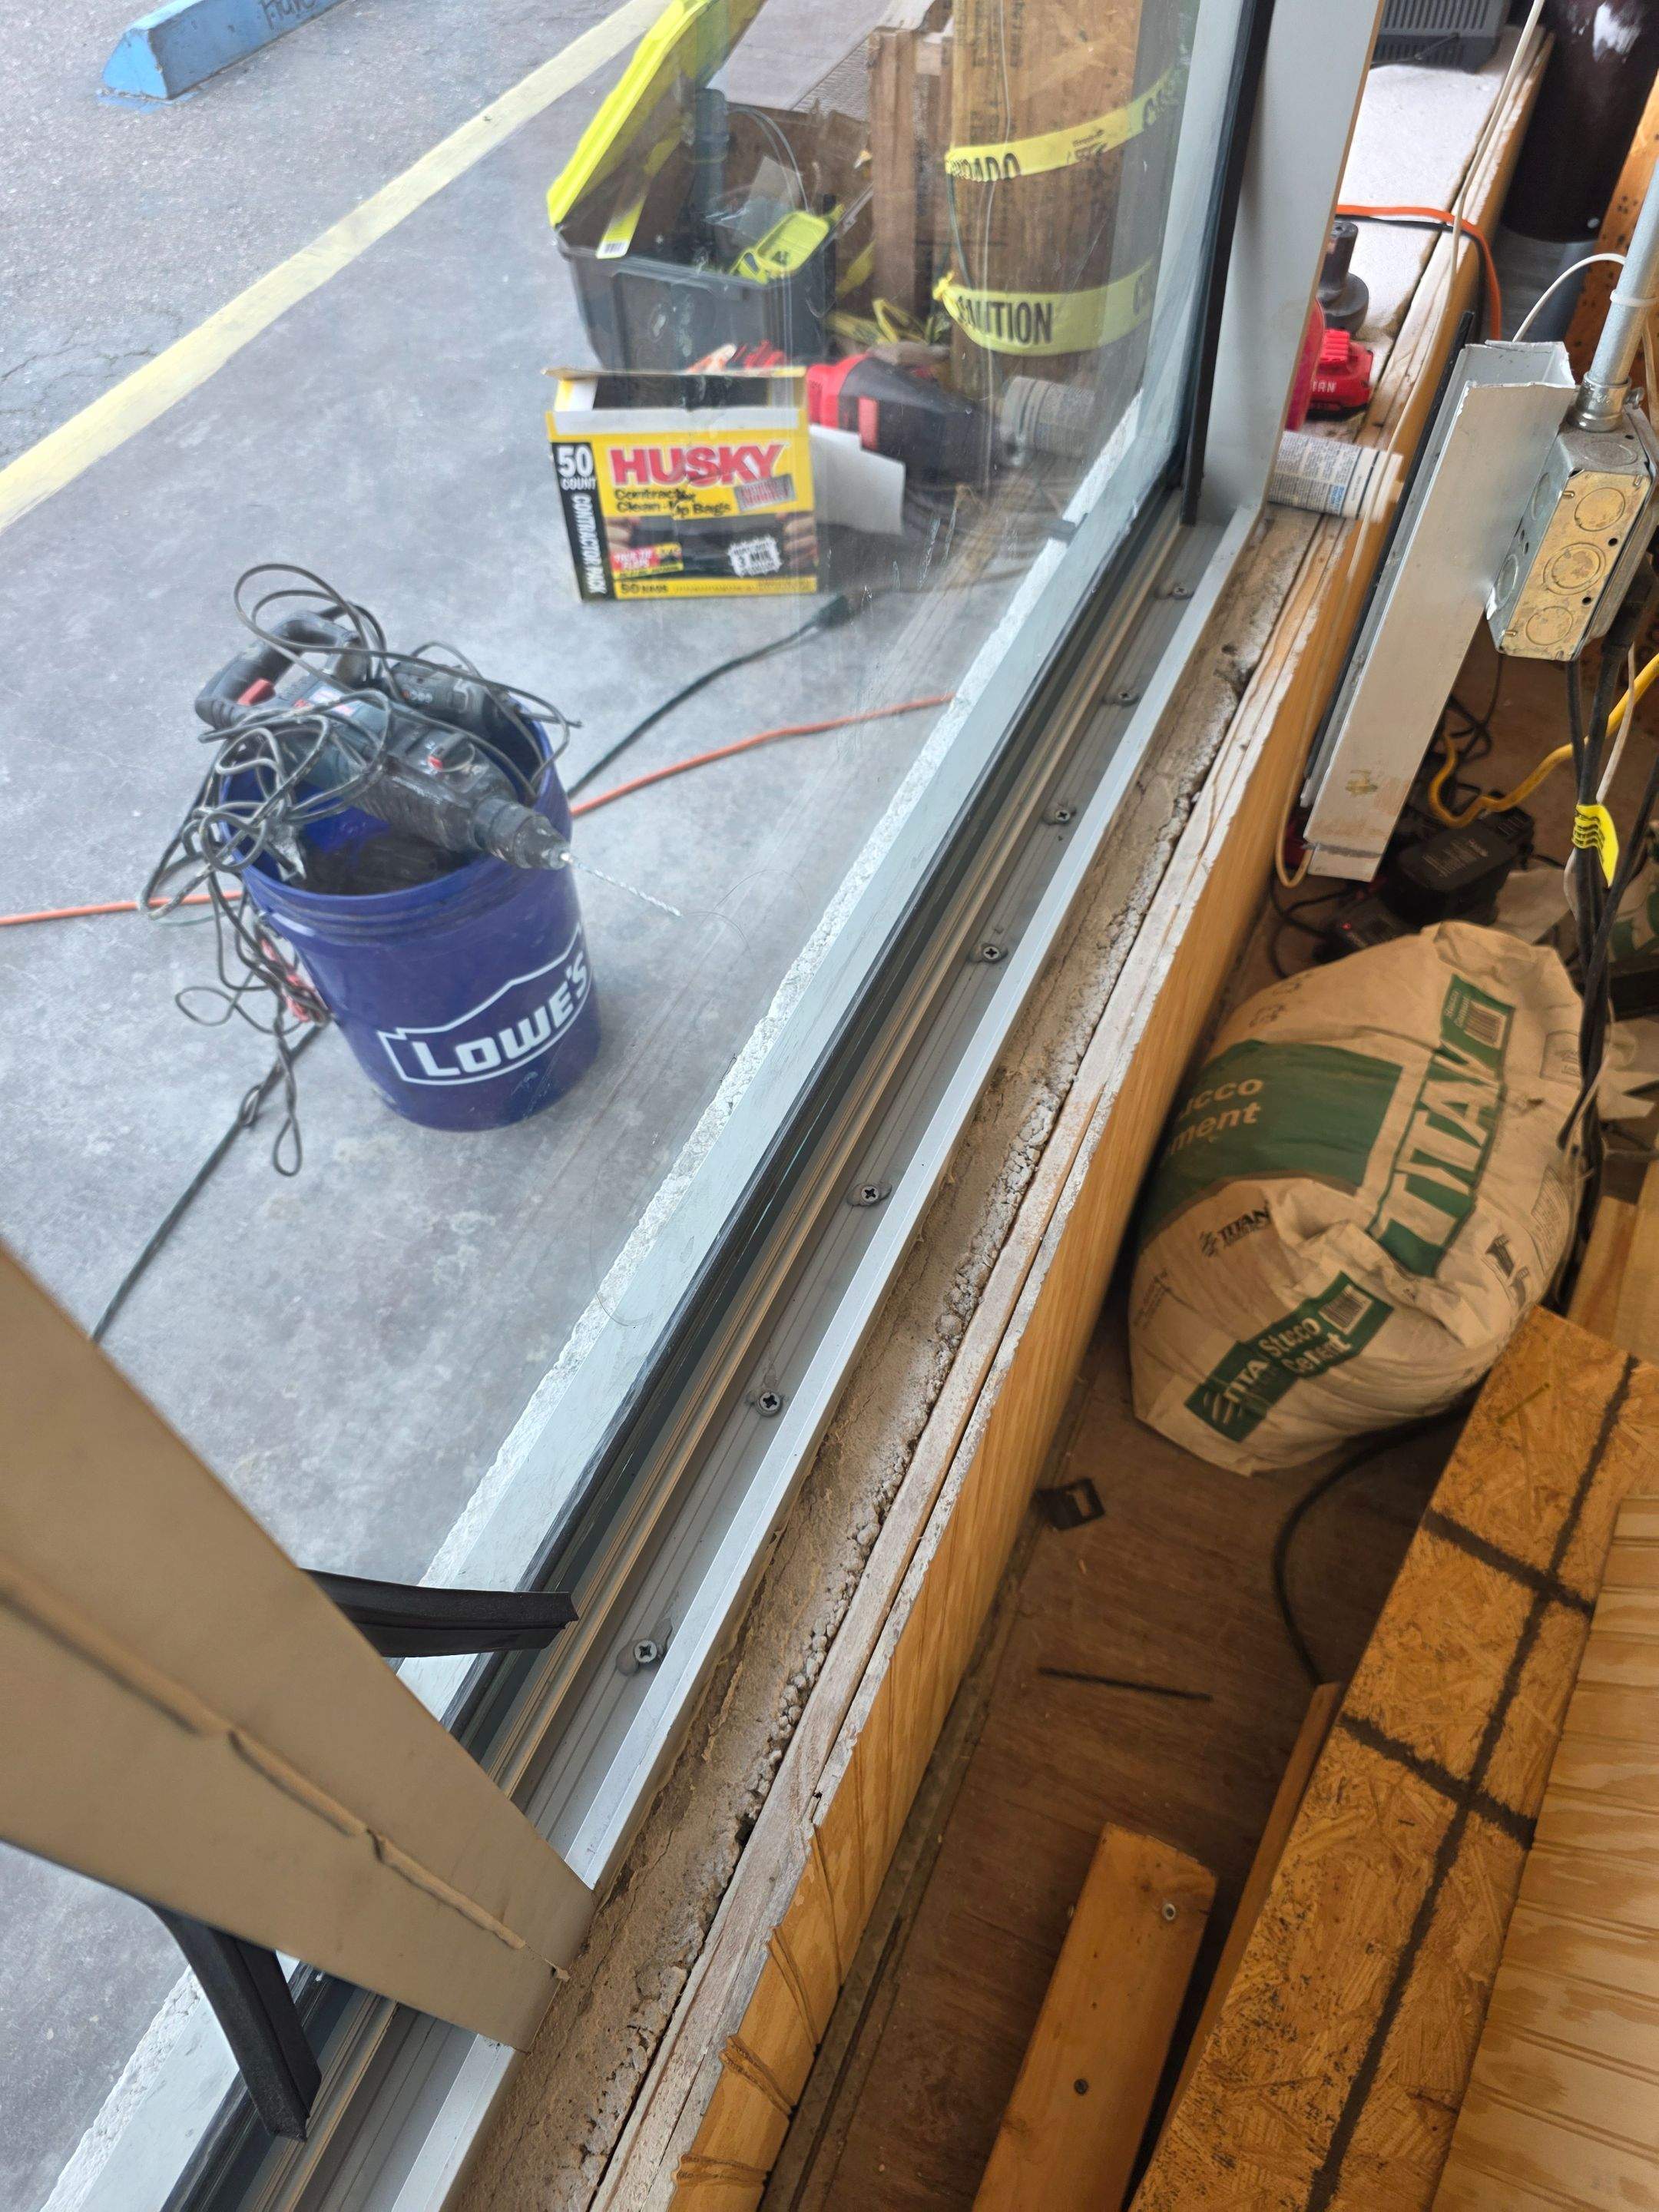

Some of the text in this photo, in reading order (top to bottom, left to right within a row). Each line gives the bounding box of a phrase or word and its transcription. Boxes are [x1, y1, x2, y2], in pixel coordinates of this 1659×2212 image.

[556, 445, 594, 478] 50
[561, 477, 596, 490] COUNT
[609, 442, 786, 486] HUSKY
[571, 493, 608, 594] CONTRACTOR PACK
[412, 952, 588, 1077] LOWE'S
[1178, 1078, 1264, 1122] ucco
[1170, 1101, 1262, 1155] ment
[1224, 1359, 1271, 1404] TITA
